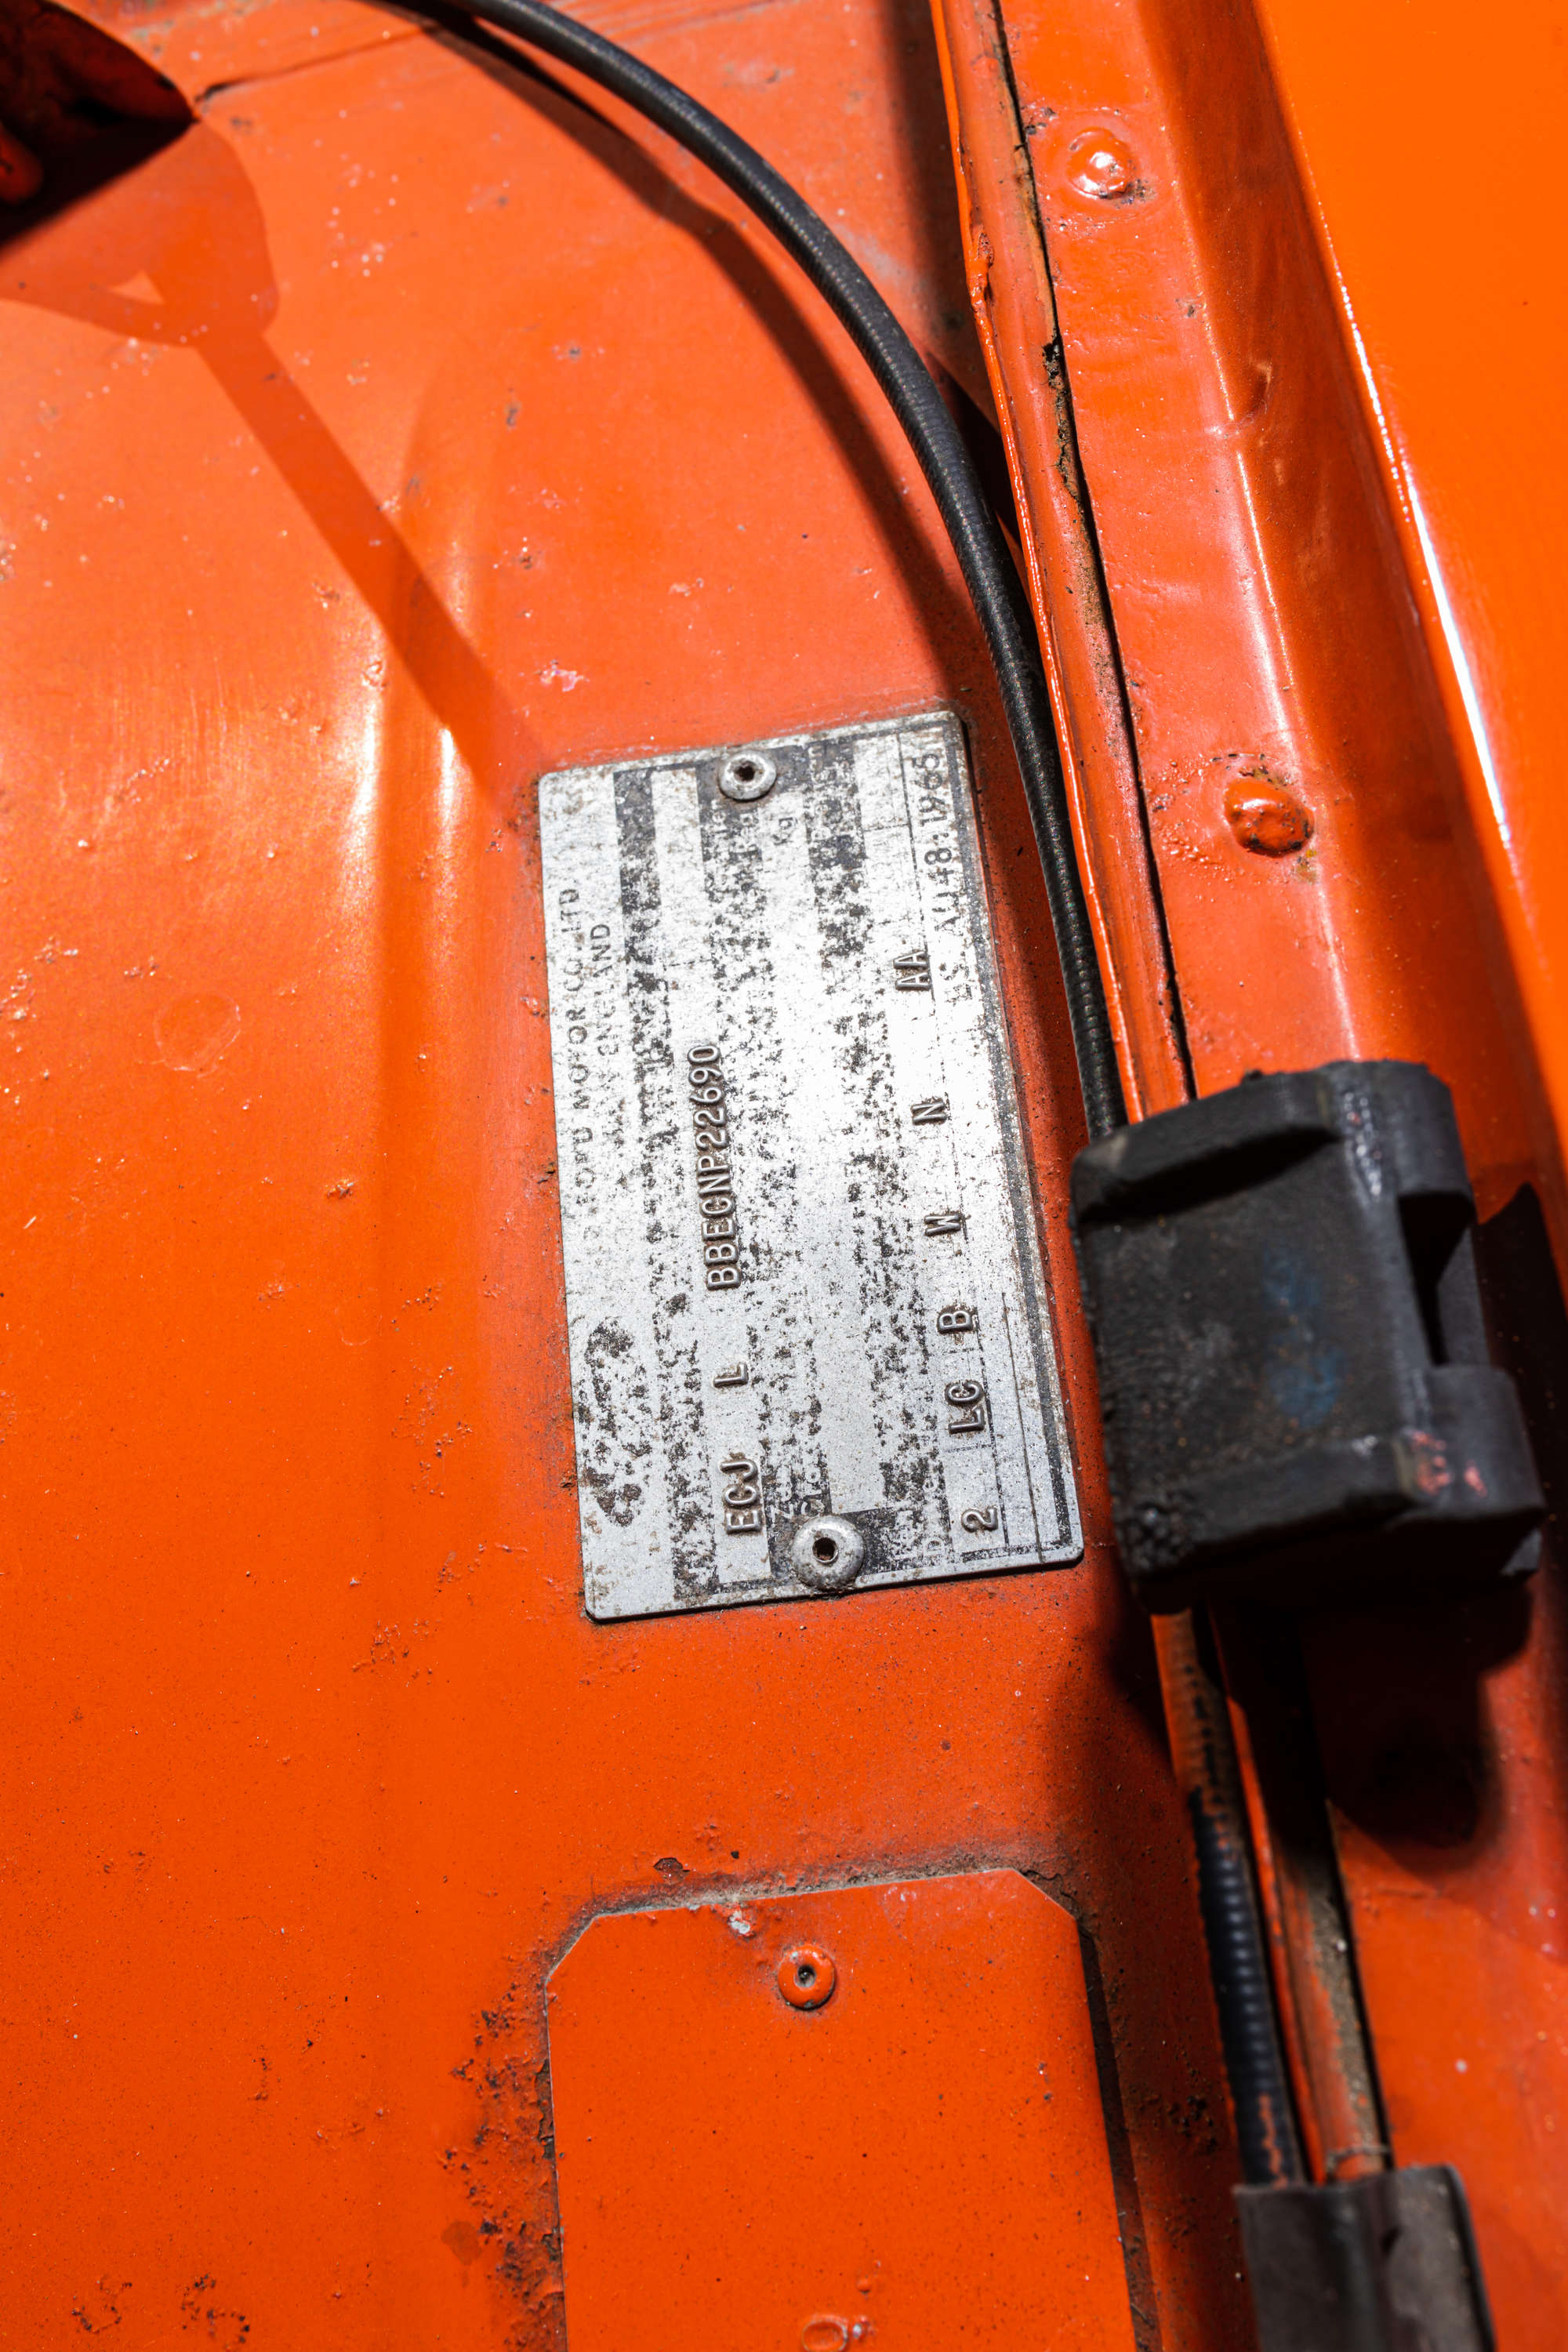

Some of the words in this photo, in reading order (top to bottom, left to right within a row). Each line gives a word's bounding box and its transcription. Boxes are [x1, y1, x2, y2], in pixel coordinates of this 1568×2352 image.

[891, 949, 932, 996] AA
[908, 1095, 949, 1127] N
[685, 1040, 742, 1291] BBECNP22690
[922, 1209, 963, 1237] W
[934, 1302, 975, 1336] B
[710, 1359, 750, 1390] L
[717, 1451, 763, 1534] ECJ
[959, 1505, 1000, 1534] 2
